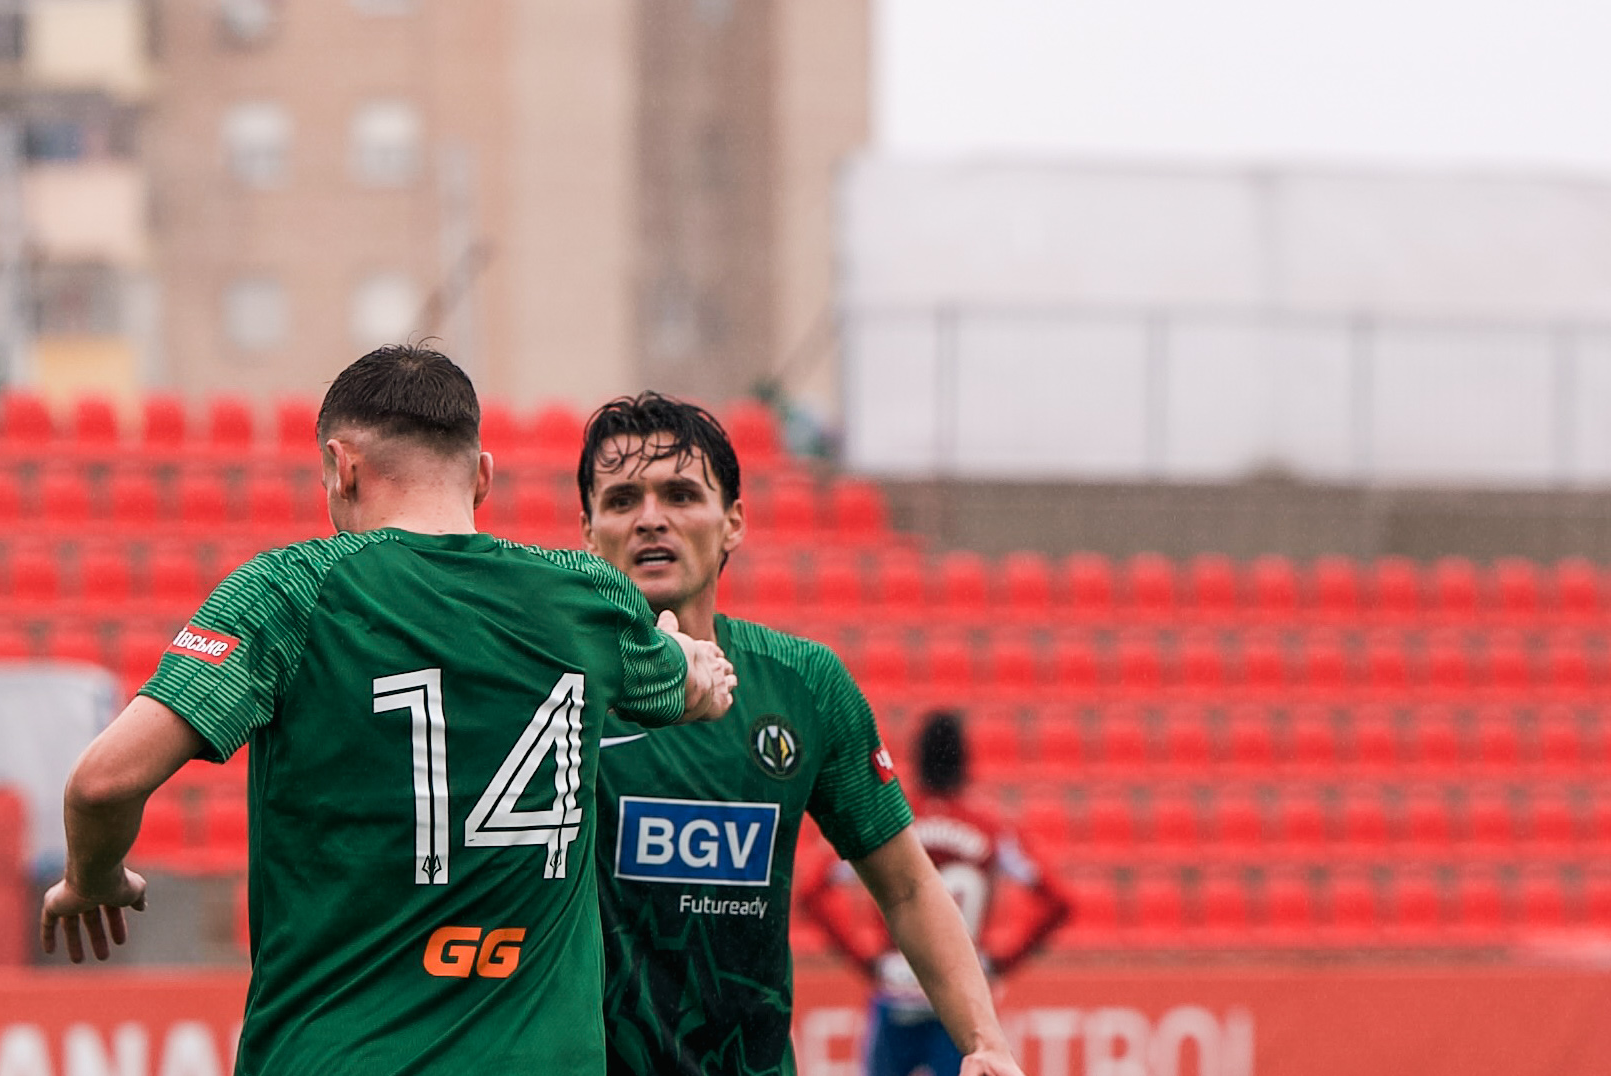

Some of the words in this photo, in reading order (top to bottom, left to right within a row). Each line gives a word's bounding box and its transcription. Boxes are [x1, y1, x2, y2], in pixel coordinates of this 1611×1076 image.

[172, 627, 229, 657] івське
[373, 667, 586, 886] 14
[635, 816, 762, 869] BGV
[679, 894, 769, 919] Futuready
[422, 926, 527, 979] GG
